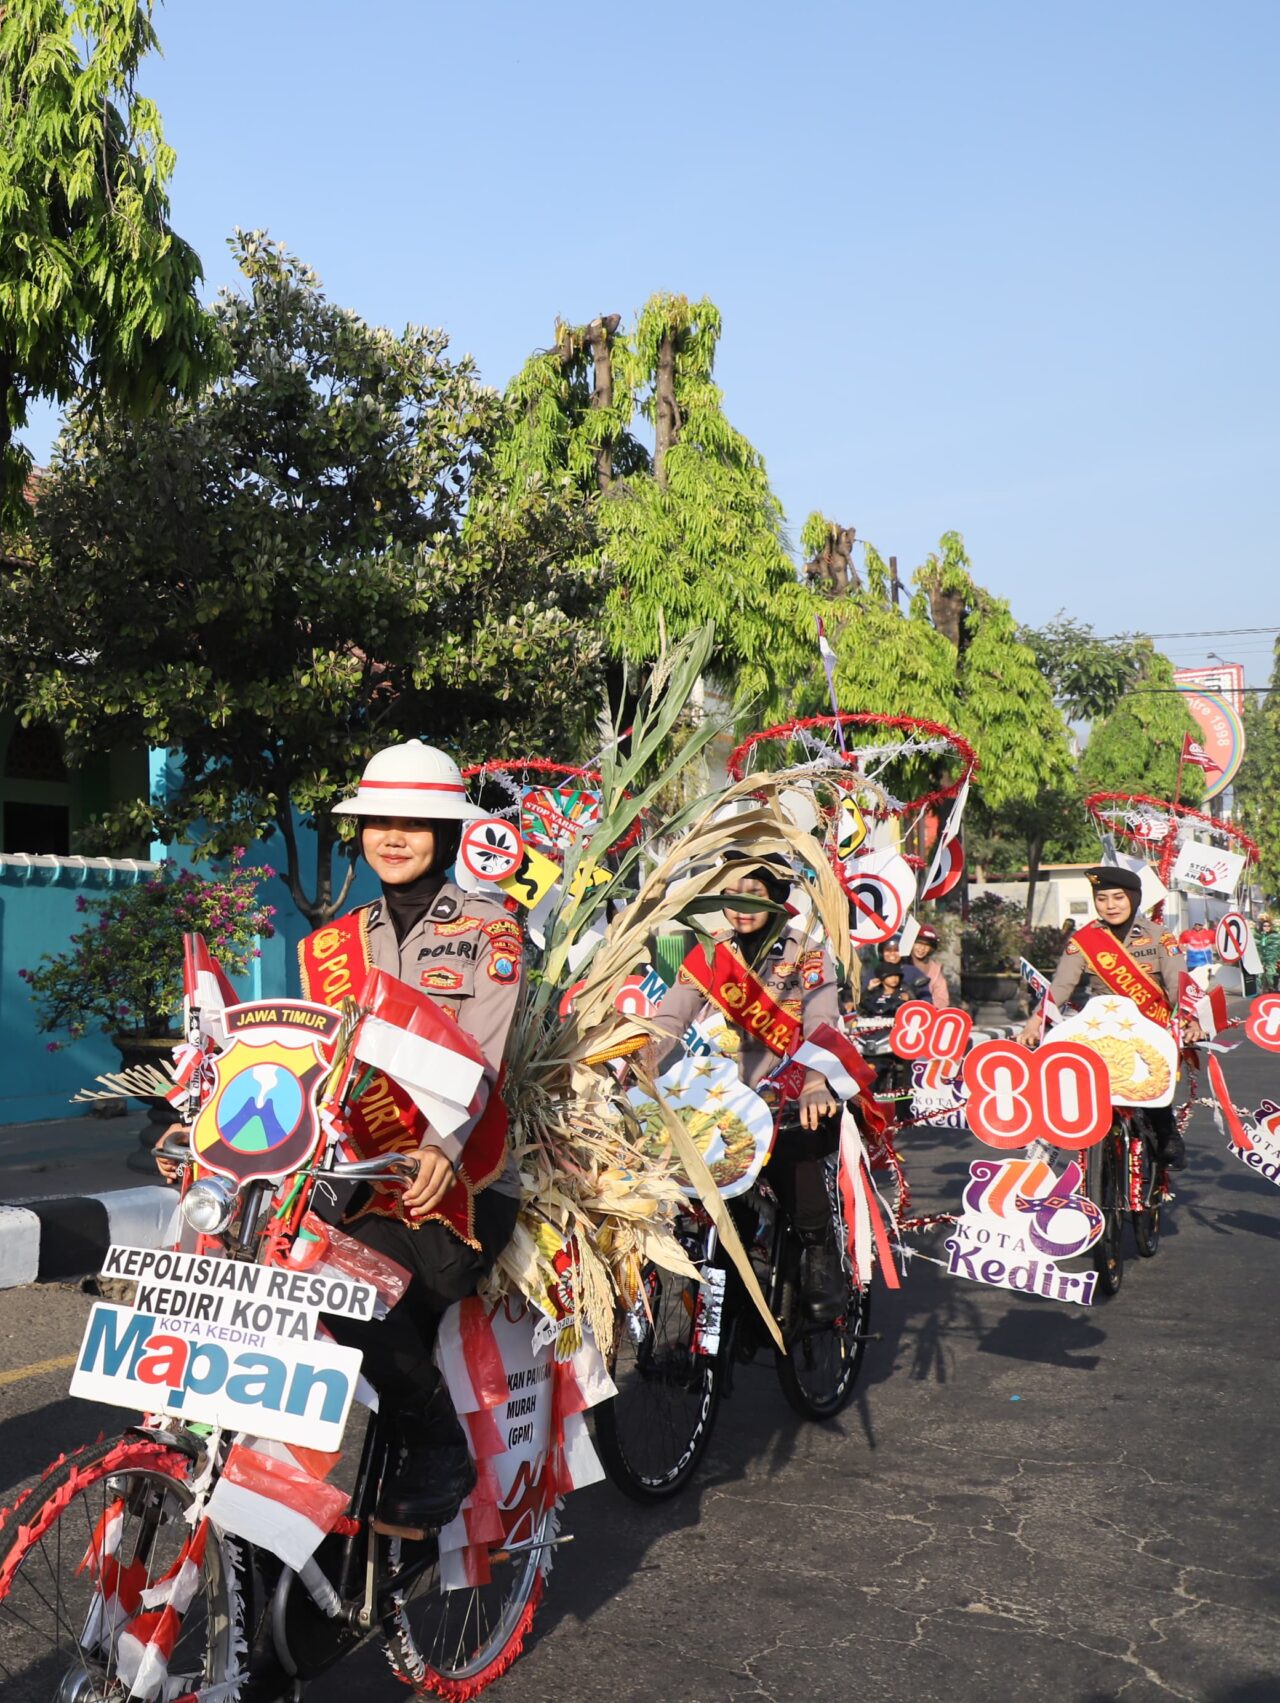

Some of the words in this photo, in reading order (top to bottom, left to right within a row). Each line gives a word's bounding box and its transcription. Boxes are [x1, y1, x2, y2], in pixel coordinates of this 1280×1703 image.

[417, 940, 478, 961] POLRI
[1109, 965, 1152, 1005] POLRES
[236, 1009, 276, 1027] JAWA
[281, 1009, 327, 1030] TIMUR
[741, 1000, 790, 1050] POLRE
[896, 1006, 965, 1060] 80
[975, 1050, 1099, 1139] 80
[956, 1223, 1026, 1252] KOTA
[105, 1247, 261, 1294] KEPOLISIAN
[267, 1271, 370, 1316] RESOR
[945, 1239, 1096, 1305] Kediri
[137, 1285, 224, 1323] KEDIRI
[230, 1298, 310, 1341] KOTA
[159, 1317, 201, 1336] KOTA
[206, 1322, 266, 1348] KEDIRI
[79, 1308, 349, 1425] Mapan
[506, 1394, 537, 1420] MURAH
[667, 1367, 714, 1482] POLICE
[508, 1421, 534, 1450] (GPM)
